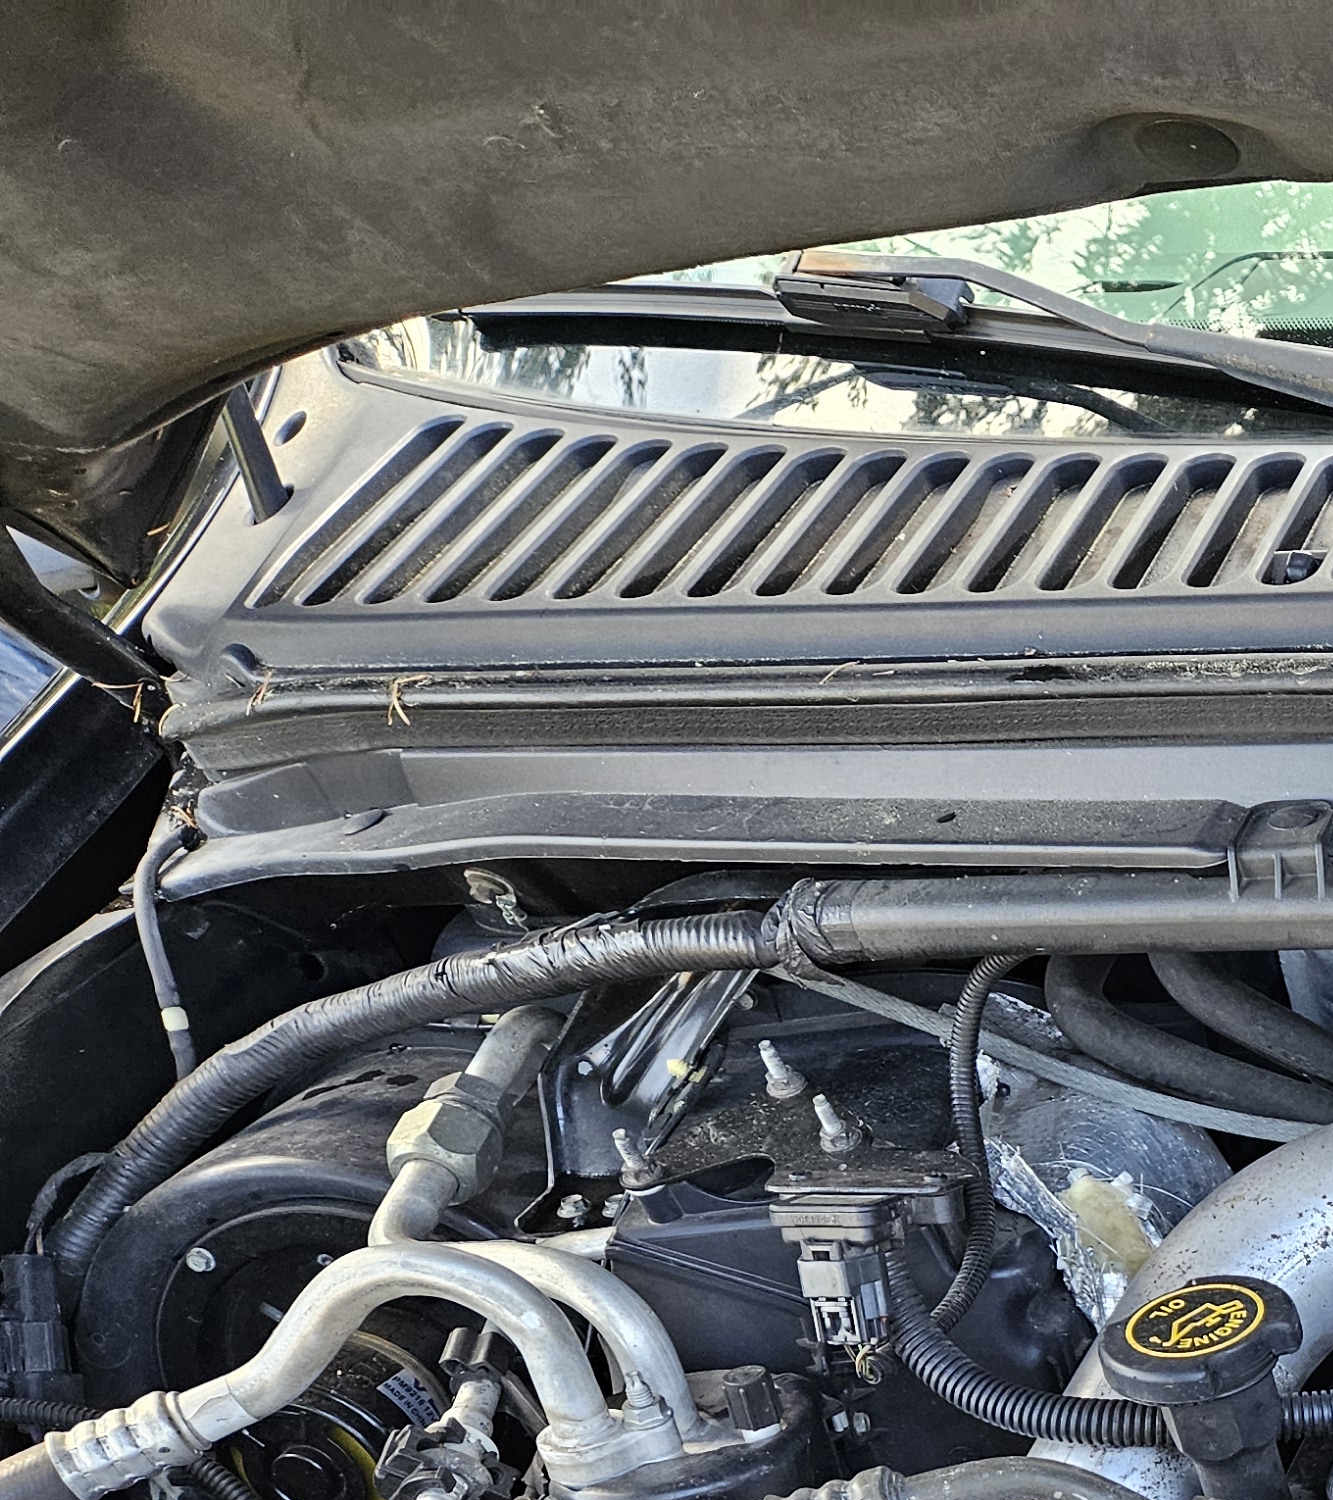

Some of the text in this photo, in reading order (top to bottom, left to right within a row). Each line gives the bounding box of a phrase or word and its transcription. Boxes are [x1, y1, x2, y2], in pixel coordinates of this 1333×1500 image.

[1149, 1298, 1186, 1319] OIL
[1177, 1309, 1247, 1349] ENGINE
[383, 1382, 407, 1401] MADE
[403, 1400, 413, 1409] IN
